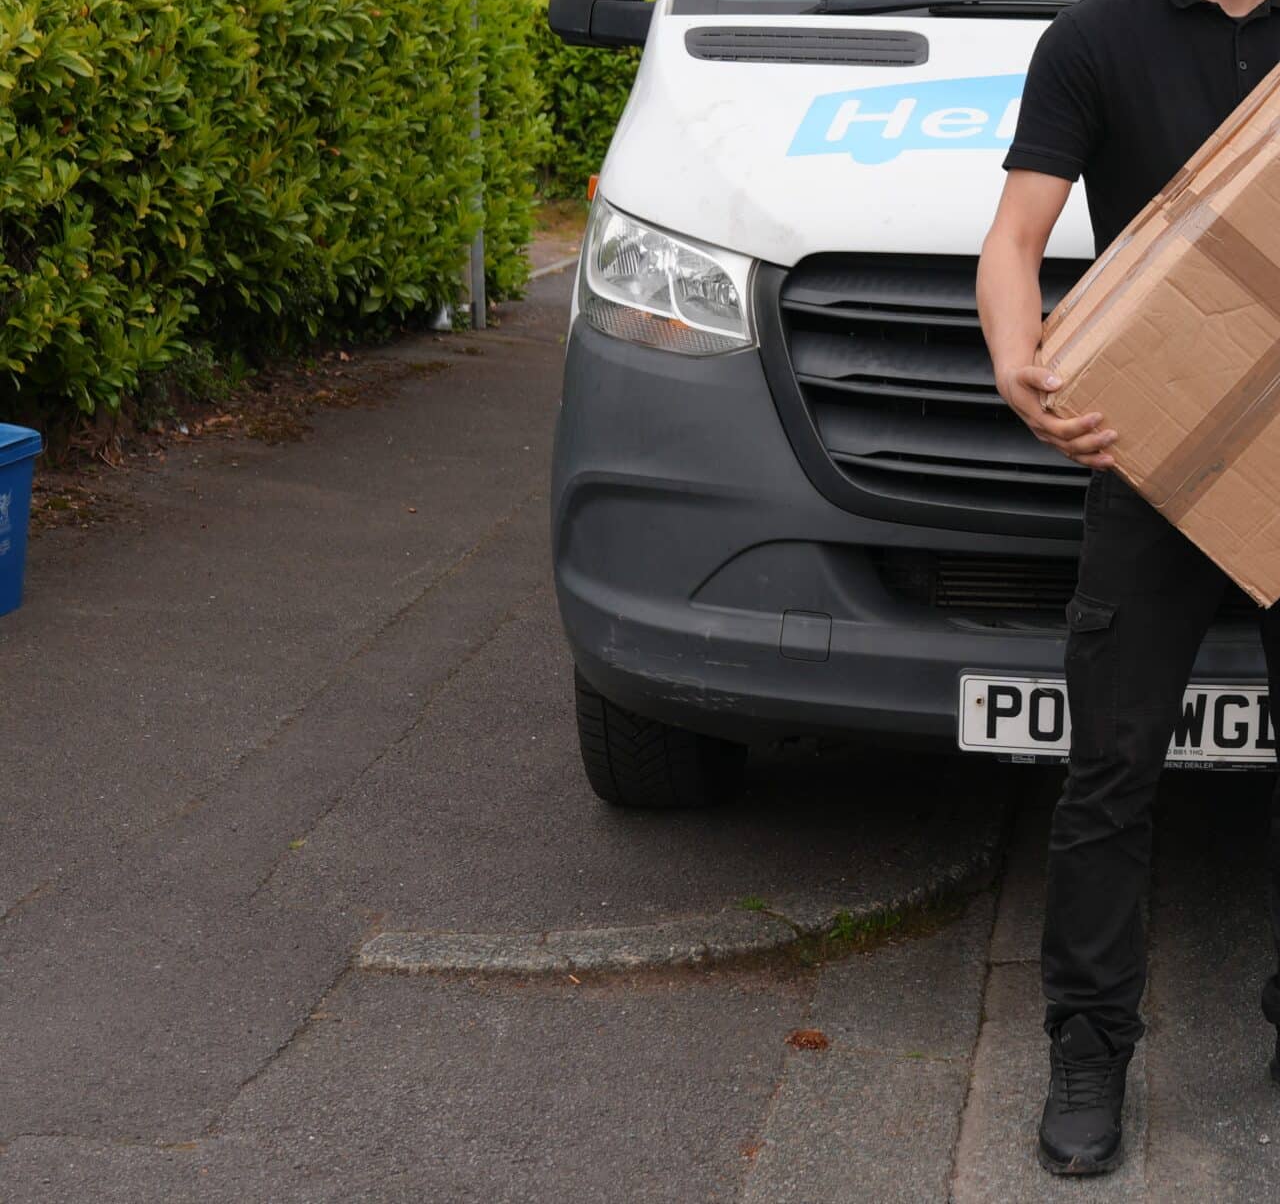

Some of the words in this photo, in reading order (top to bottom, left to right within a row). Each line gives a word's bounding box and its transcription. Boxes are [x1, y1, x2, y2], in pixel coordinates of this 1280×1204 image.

[826, 98, 1021, 142] Hel
[986, 685, 1064, 741] PO
[1184, 761, 1214, 769] DEALER
